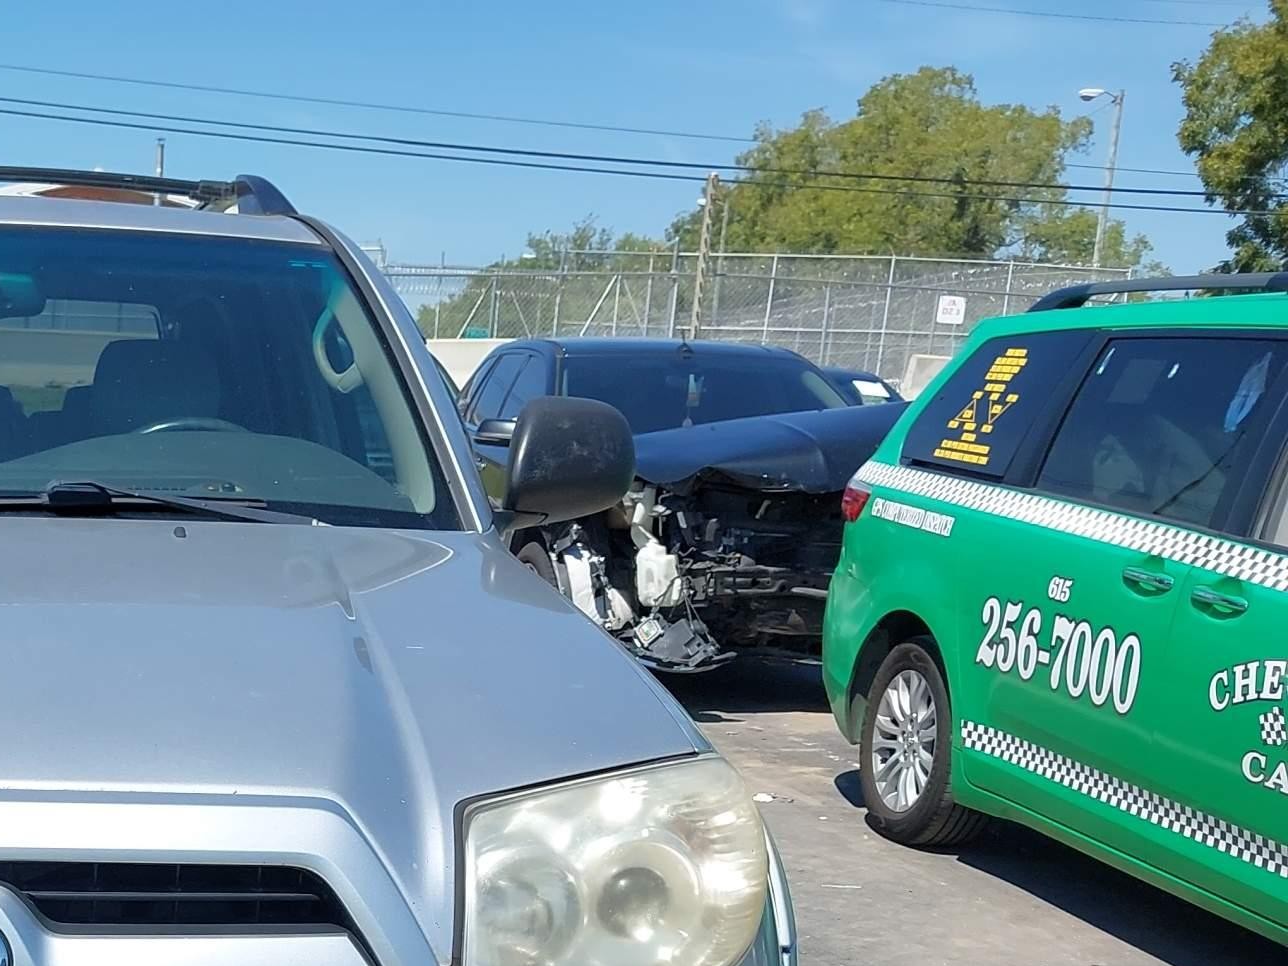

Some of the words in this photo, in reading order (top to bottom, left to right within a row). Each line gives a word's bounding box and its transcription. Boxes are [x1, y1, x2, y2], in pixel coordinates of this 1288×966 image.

[1047, 575, 1073, 602] 615
[975, 597, 1142, 714] 256-7000
[1209, 660, 1288, 711] CHE
